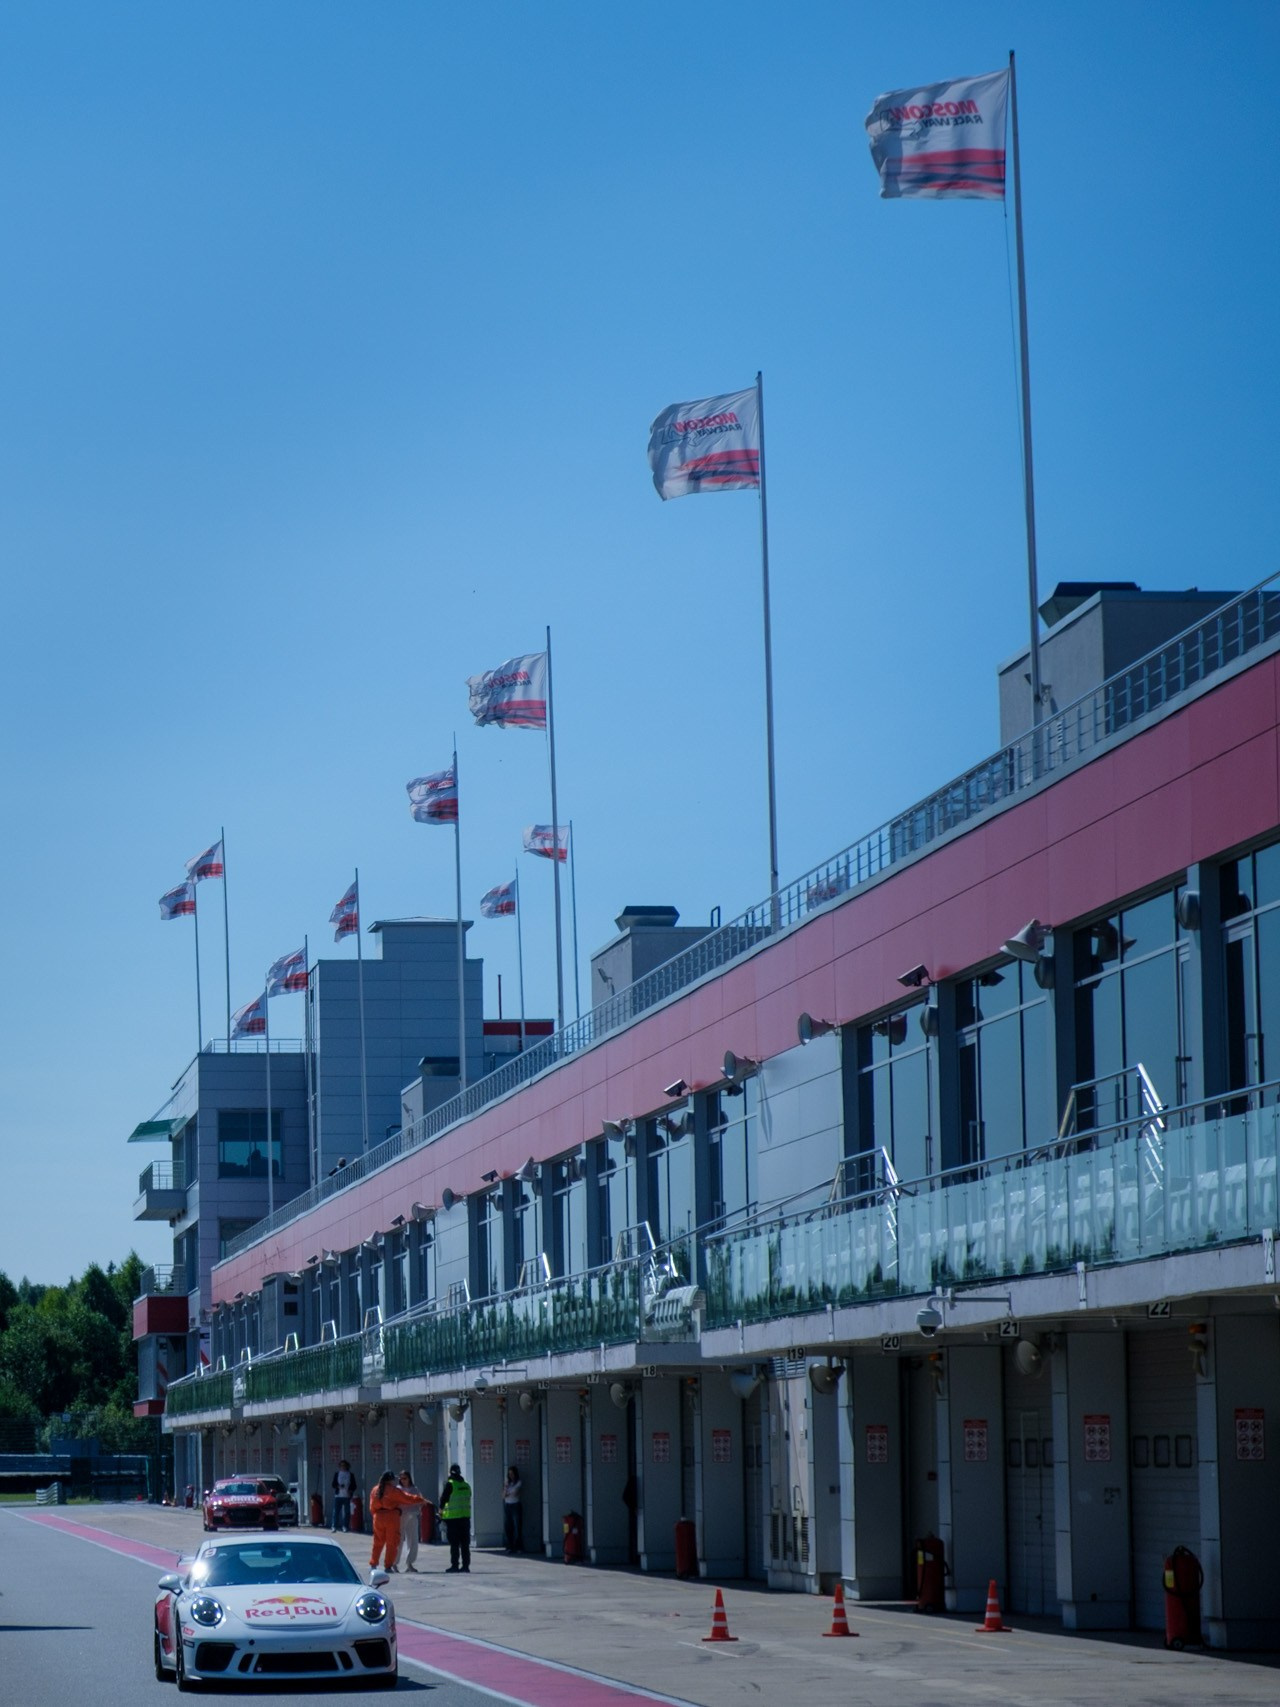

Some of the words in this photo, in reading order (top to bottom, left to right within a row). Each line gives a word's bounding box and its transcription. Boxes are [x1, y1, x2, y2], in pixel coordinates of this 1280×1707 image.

[1150, 1302, 1169, 1316] 22
[1003, 1322, 1018, 1334] 21
[884, 1337, 899, 1348] 20
[792, 1349, 804, 1359] 19
[644, 1366, 655, 1376] 18
[588, 1375, 598, 1383] 17
[497, 1386, 507, 1394] 15
[245, 1606, 290, 1619] Red
[294, 1606, 337, 1616] Bull
